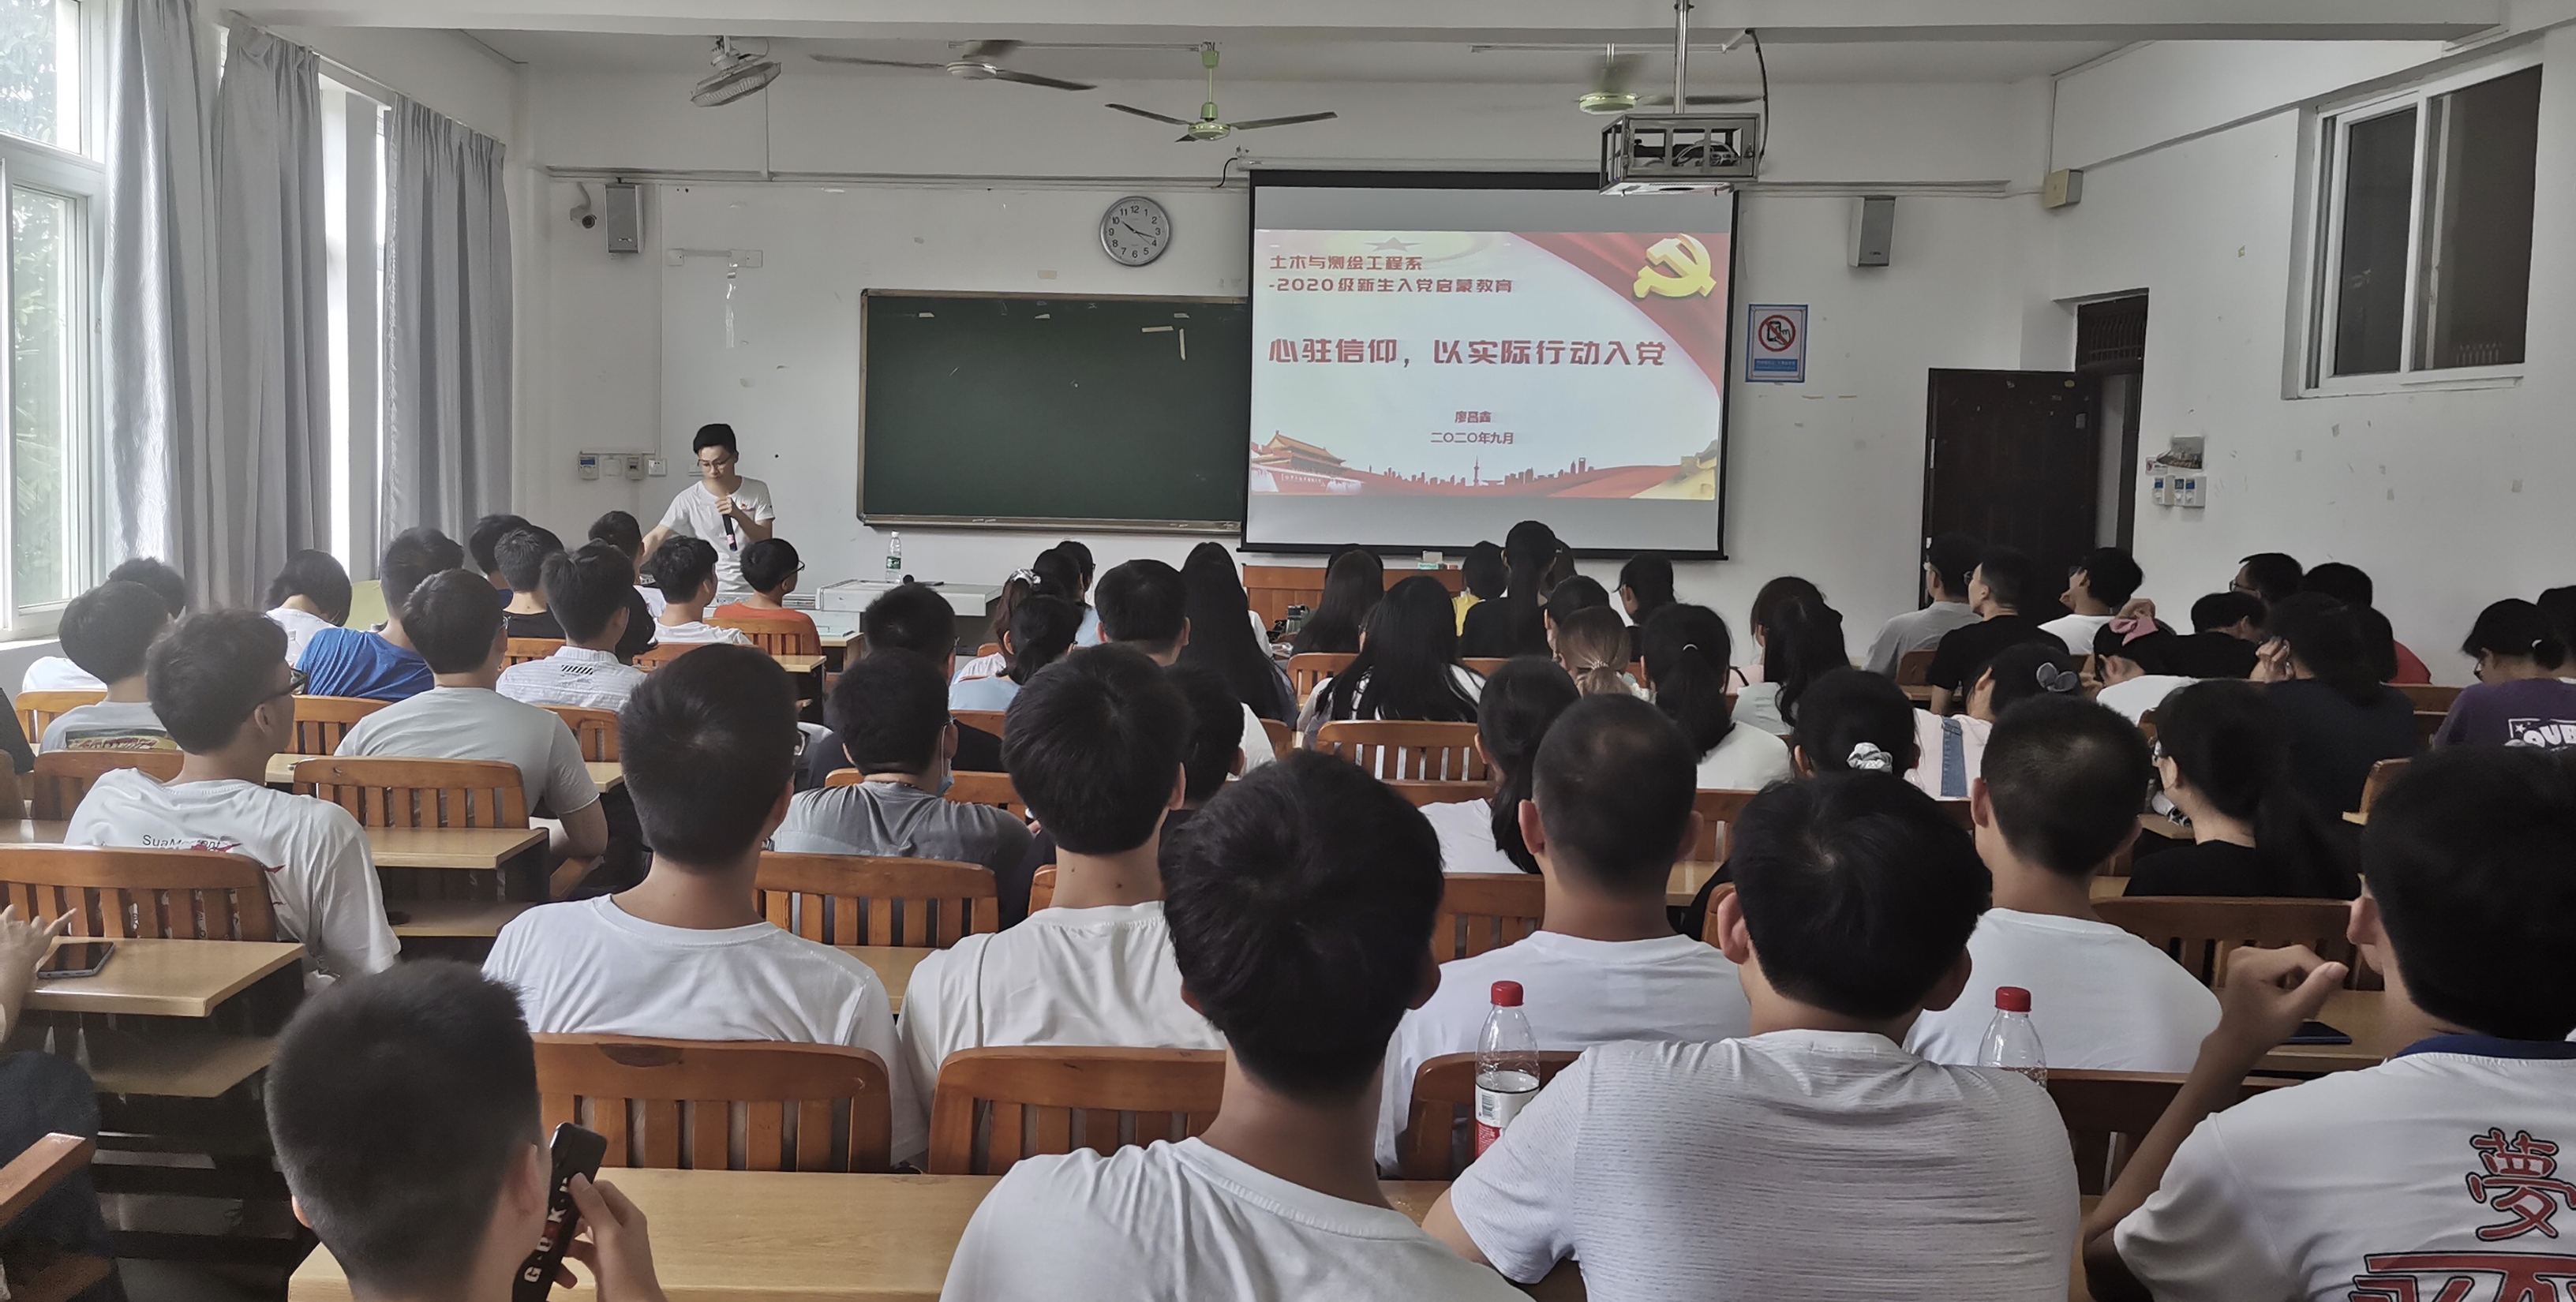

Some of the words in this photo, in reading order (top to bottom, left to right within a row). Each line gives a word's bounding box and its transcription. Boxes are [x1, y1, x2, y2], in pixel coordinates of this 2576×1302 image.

[1269, 255, 1423, 271] 土木与测绘工程系
[2466, 1127, 2576, 1241] 夢
